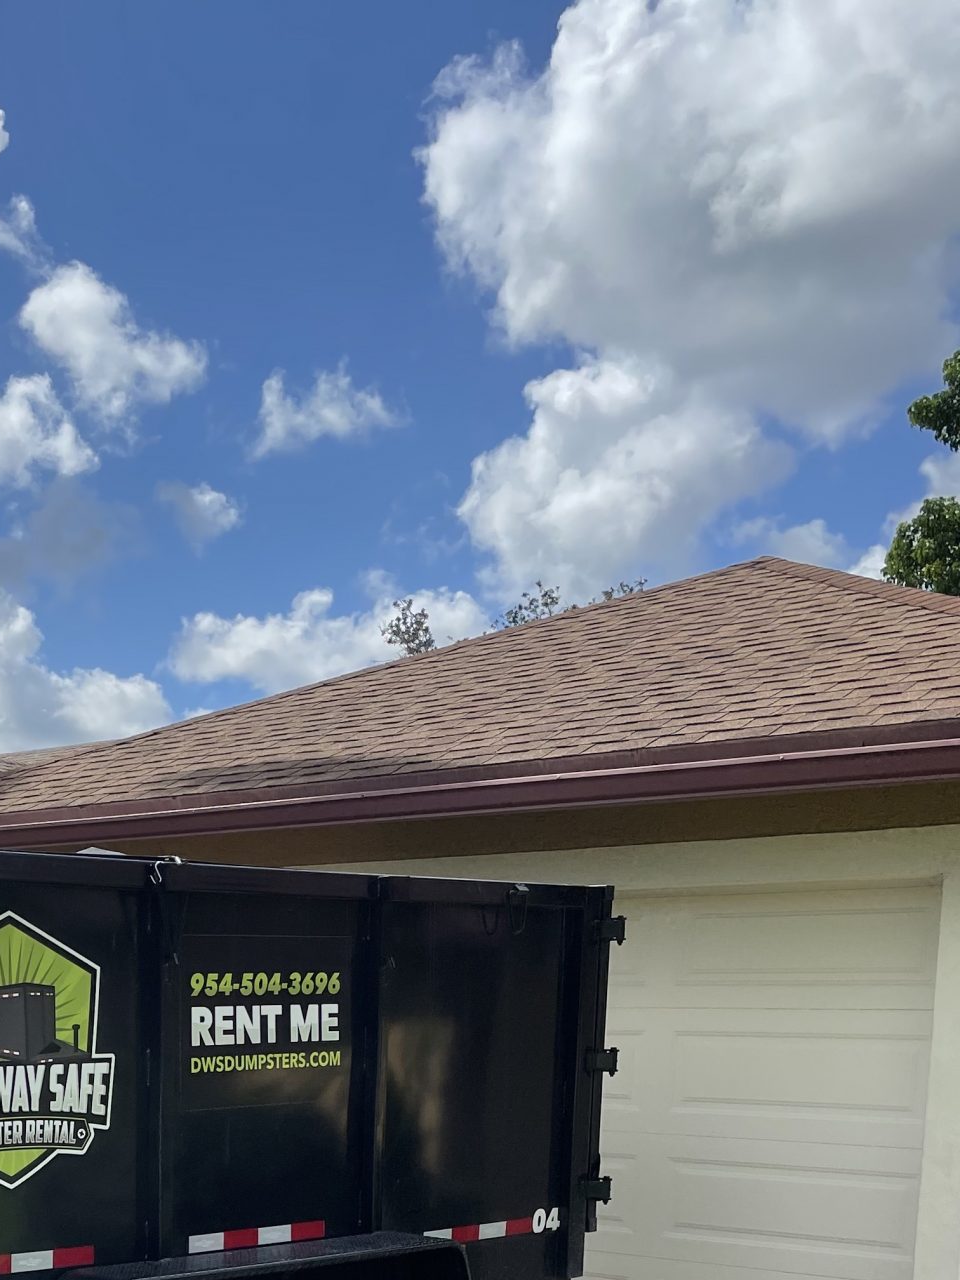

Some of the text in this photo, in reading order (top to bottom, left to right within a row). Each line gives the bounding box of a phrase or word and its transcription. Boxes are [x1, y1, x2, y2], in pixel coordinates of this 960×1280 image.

[190, 972, 341, 997] 954-504-3696
[191, 1003, 340, 1047] RENT ME
[191, 1050, 341, 1074] DWSDUMPSTERS.COM
[49, 1062, 110, 1116] SAFE
[25, 1120, 77, 1145] RENTAL
[533, 1207, 560, 1233] 04
